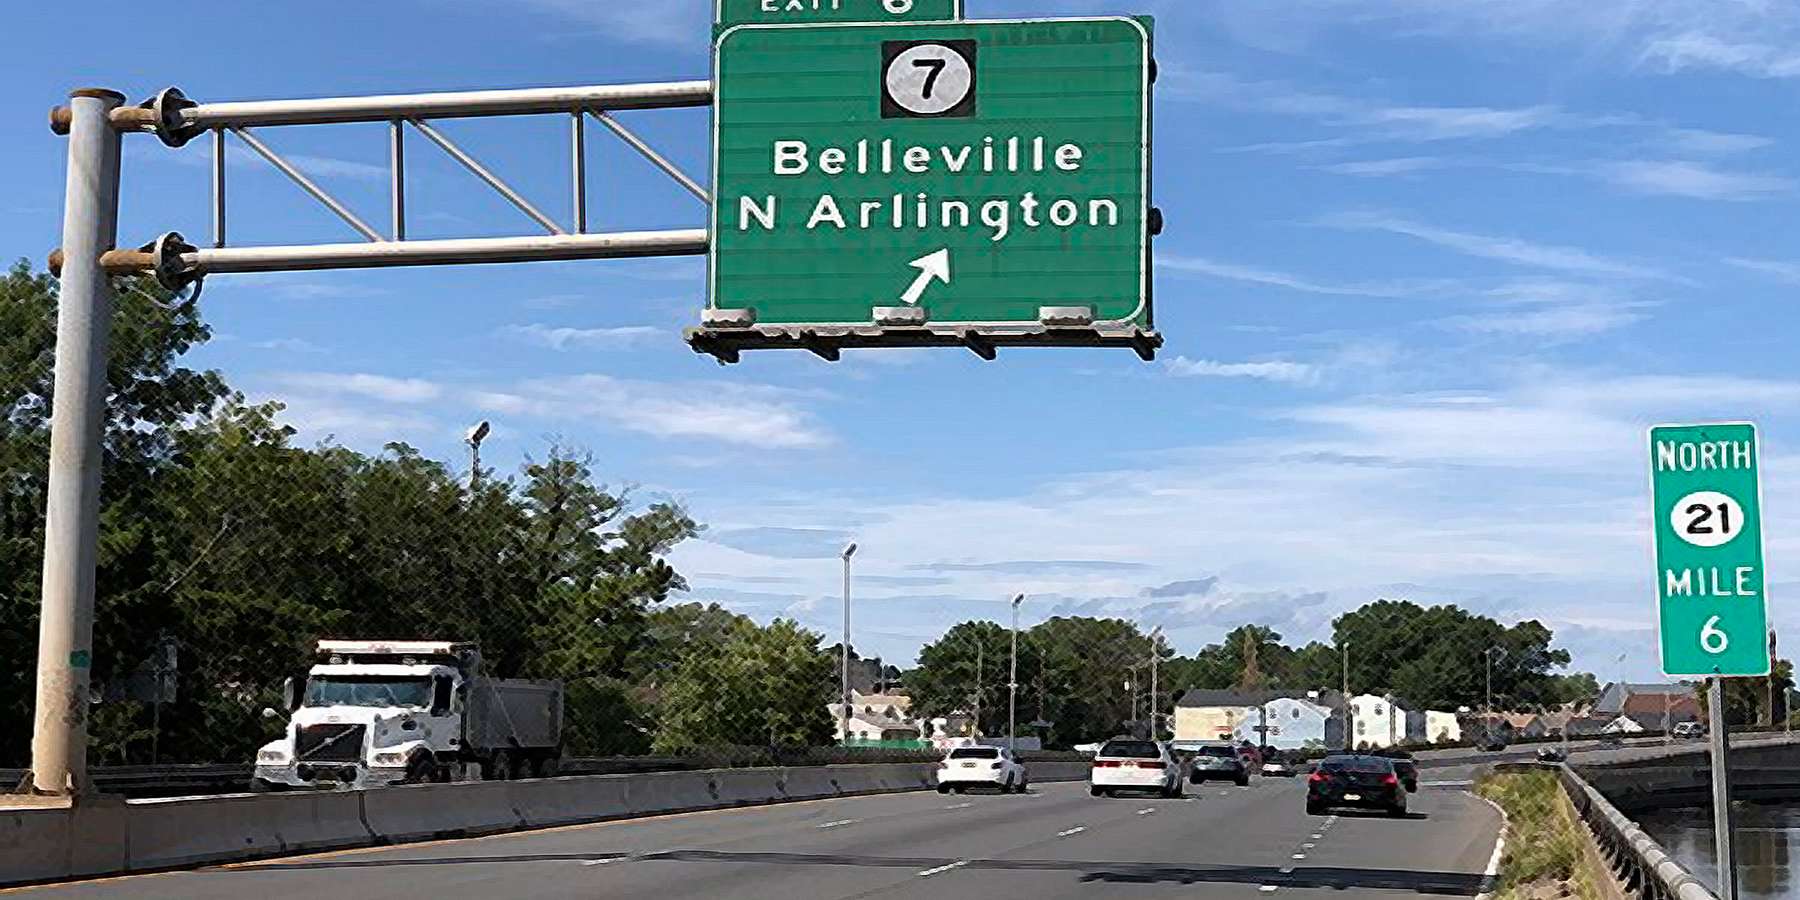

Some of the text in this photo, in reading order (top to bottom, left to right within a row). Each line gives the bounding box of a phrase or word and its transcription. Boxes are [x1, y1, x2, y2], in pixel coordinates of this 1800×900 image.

[911, 58, 946, 100] 7
[773, 136, 1083, 175] Belleville
[738, 191, 1118, 241] N Arlington
[1656, 440, 1752, 472] NORTH
[1686, 502, 1730, 534] 21
[1665, 566, 1757, 597] MILE
[1700, 615, 1728, 654] 6
